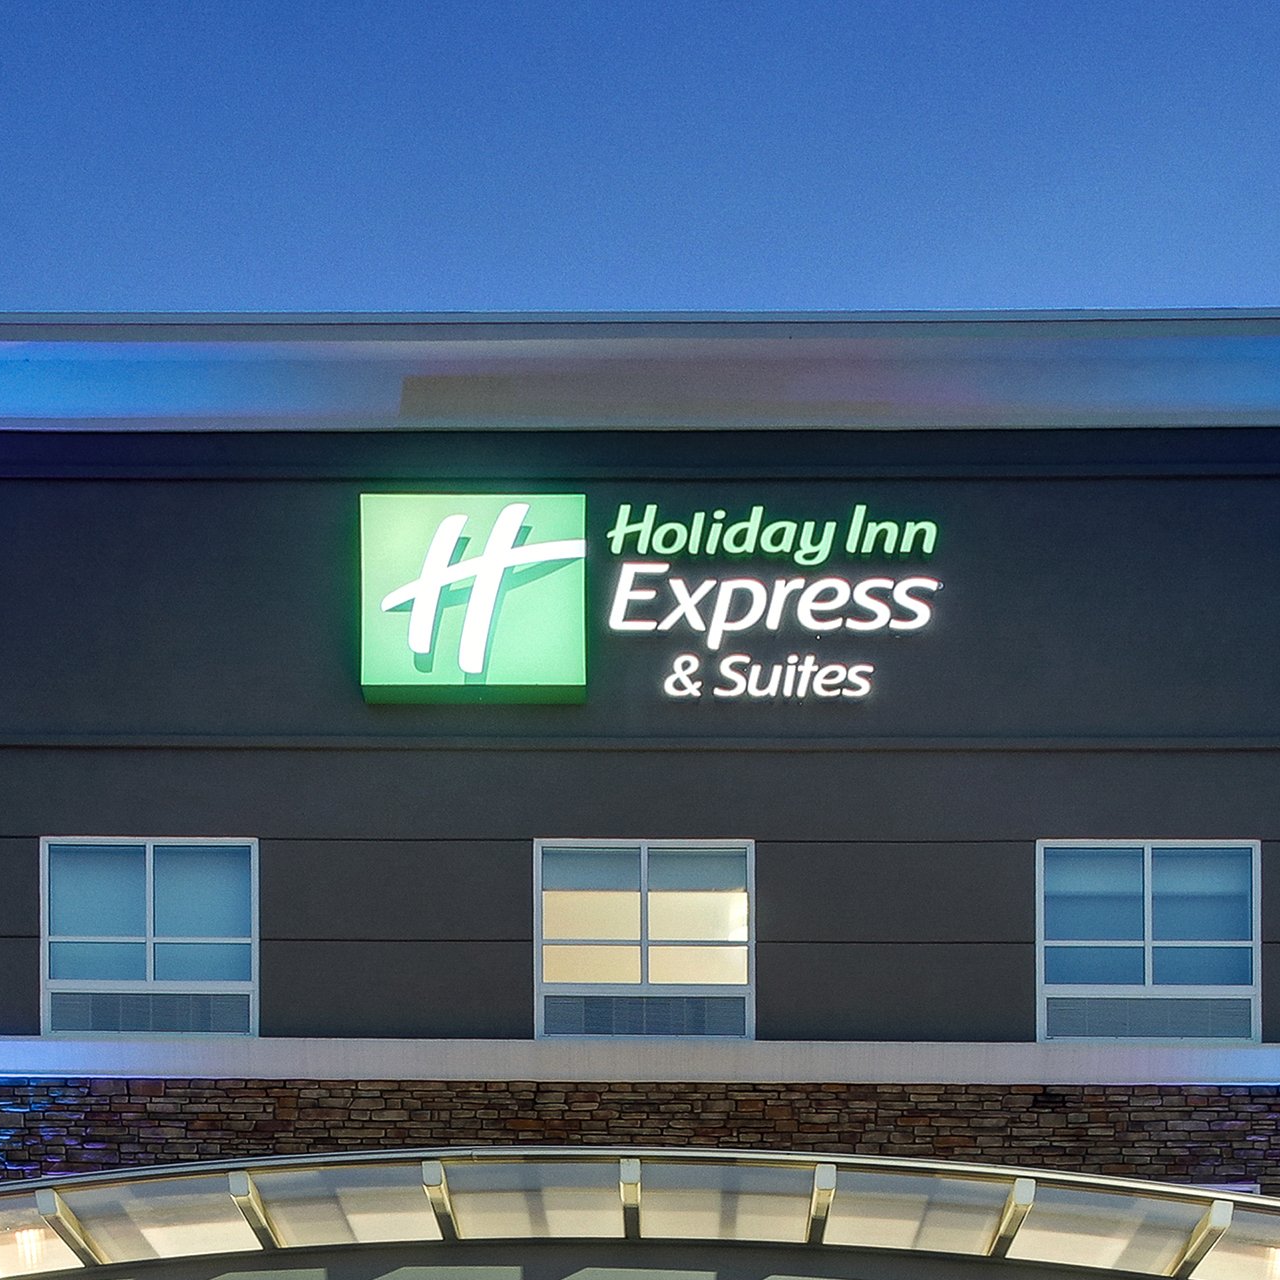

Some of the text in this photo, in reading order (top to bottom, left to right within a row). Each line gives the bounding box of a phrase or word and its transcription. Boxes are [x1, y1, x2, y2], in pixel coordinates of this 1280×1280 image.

[606, 504, 938, 566] Holiday Inn
[608, 561, 940, 651] Express
[663, 653, 876, 698] & Suites
